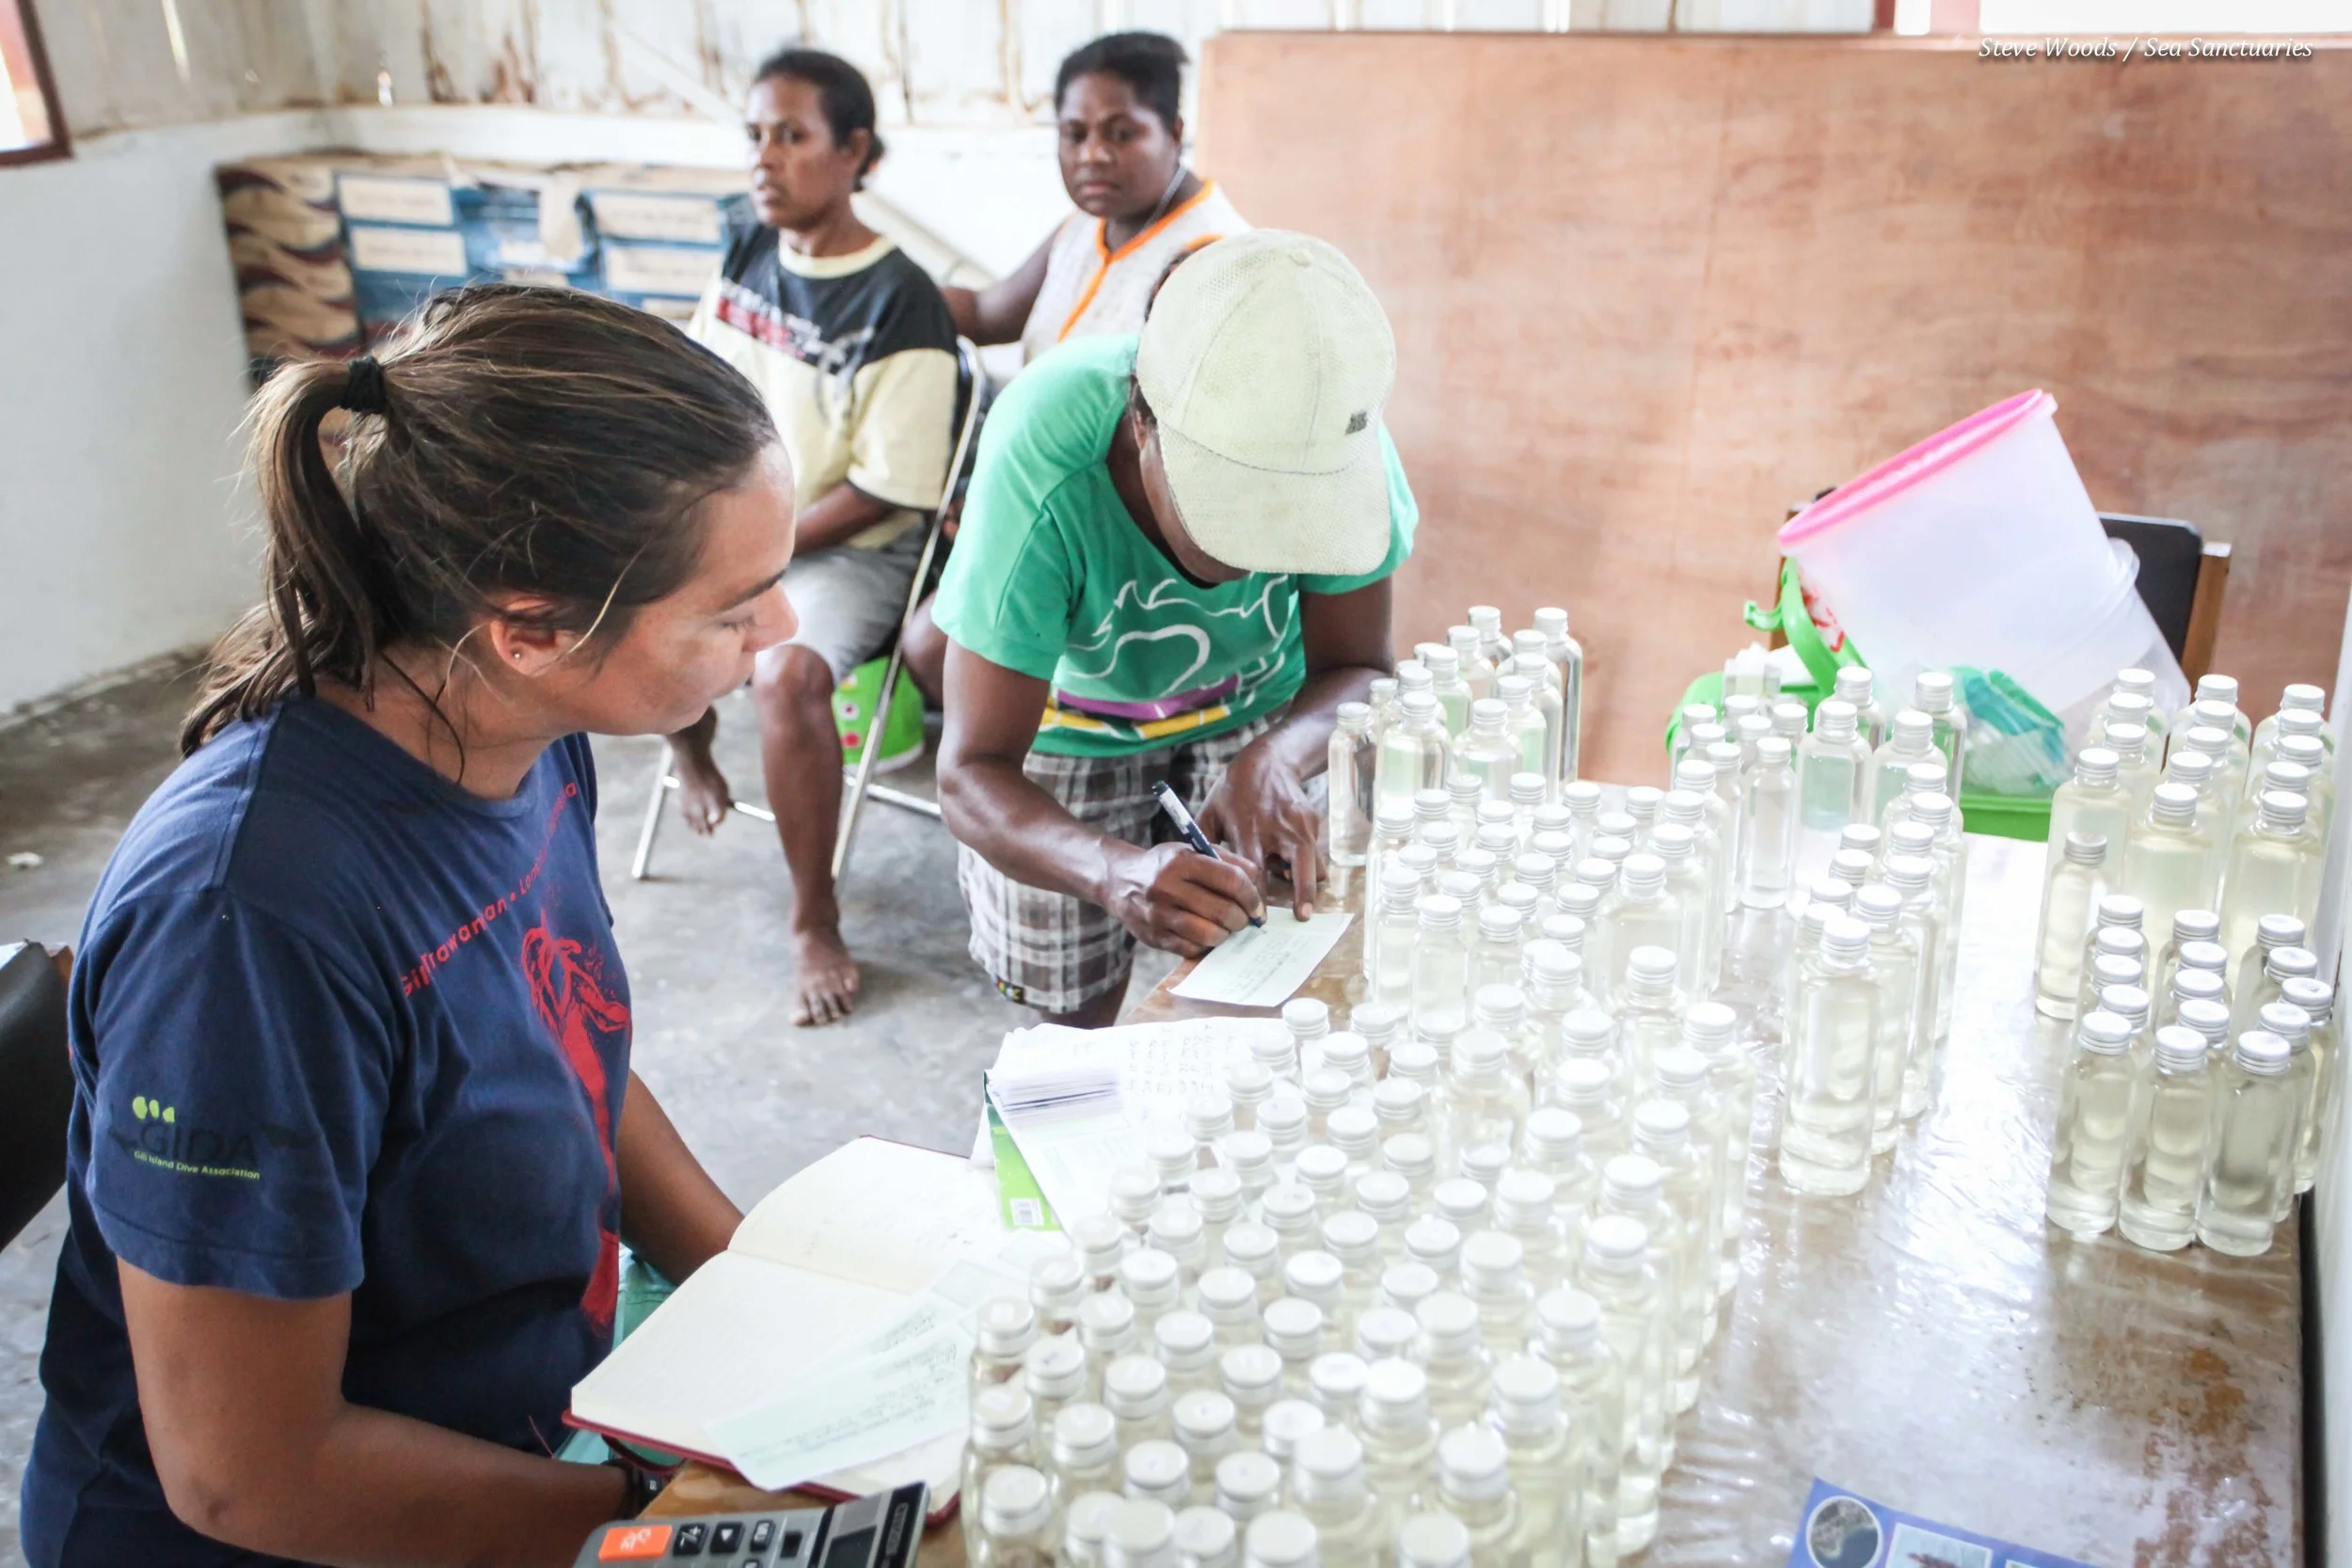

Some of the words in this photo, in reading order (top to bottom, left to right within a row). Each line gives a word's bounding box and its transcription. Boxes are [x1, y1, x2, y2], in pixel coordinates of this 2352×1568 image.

[141, 1121, 258, 1168] GIDA
[134, 1149, 148, 1162] Gili
[149, 1154, 174, 1169] Island
[176, 1162, 199, 1174] Dive
[200, 1164, 261, 1180] Association
